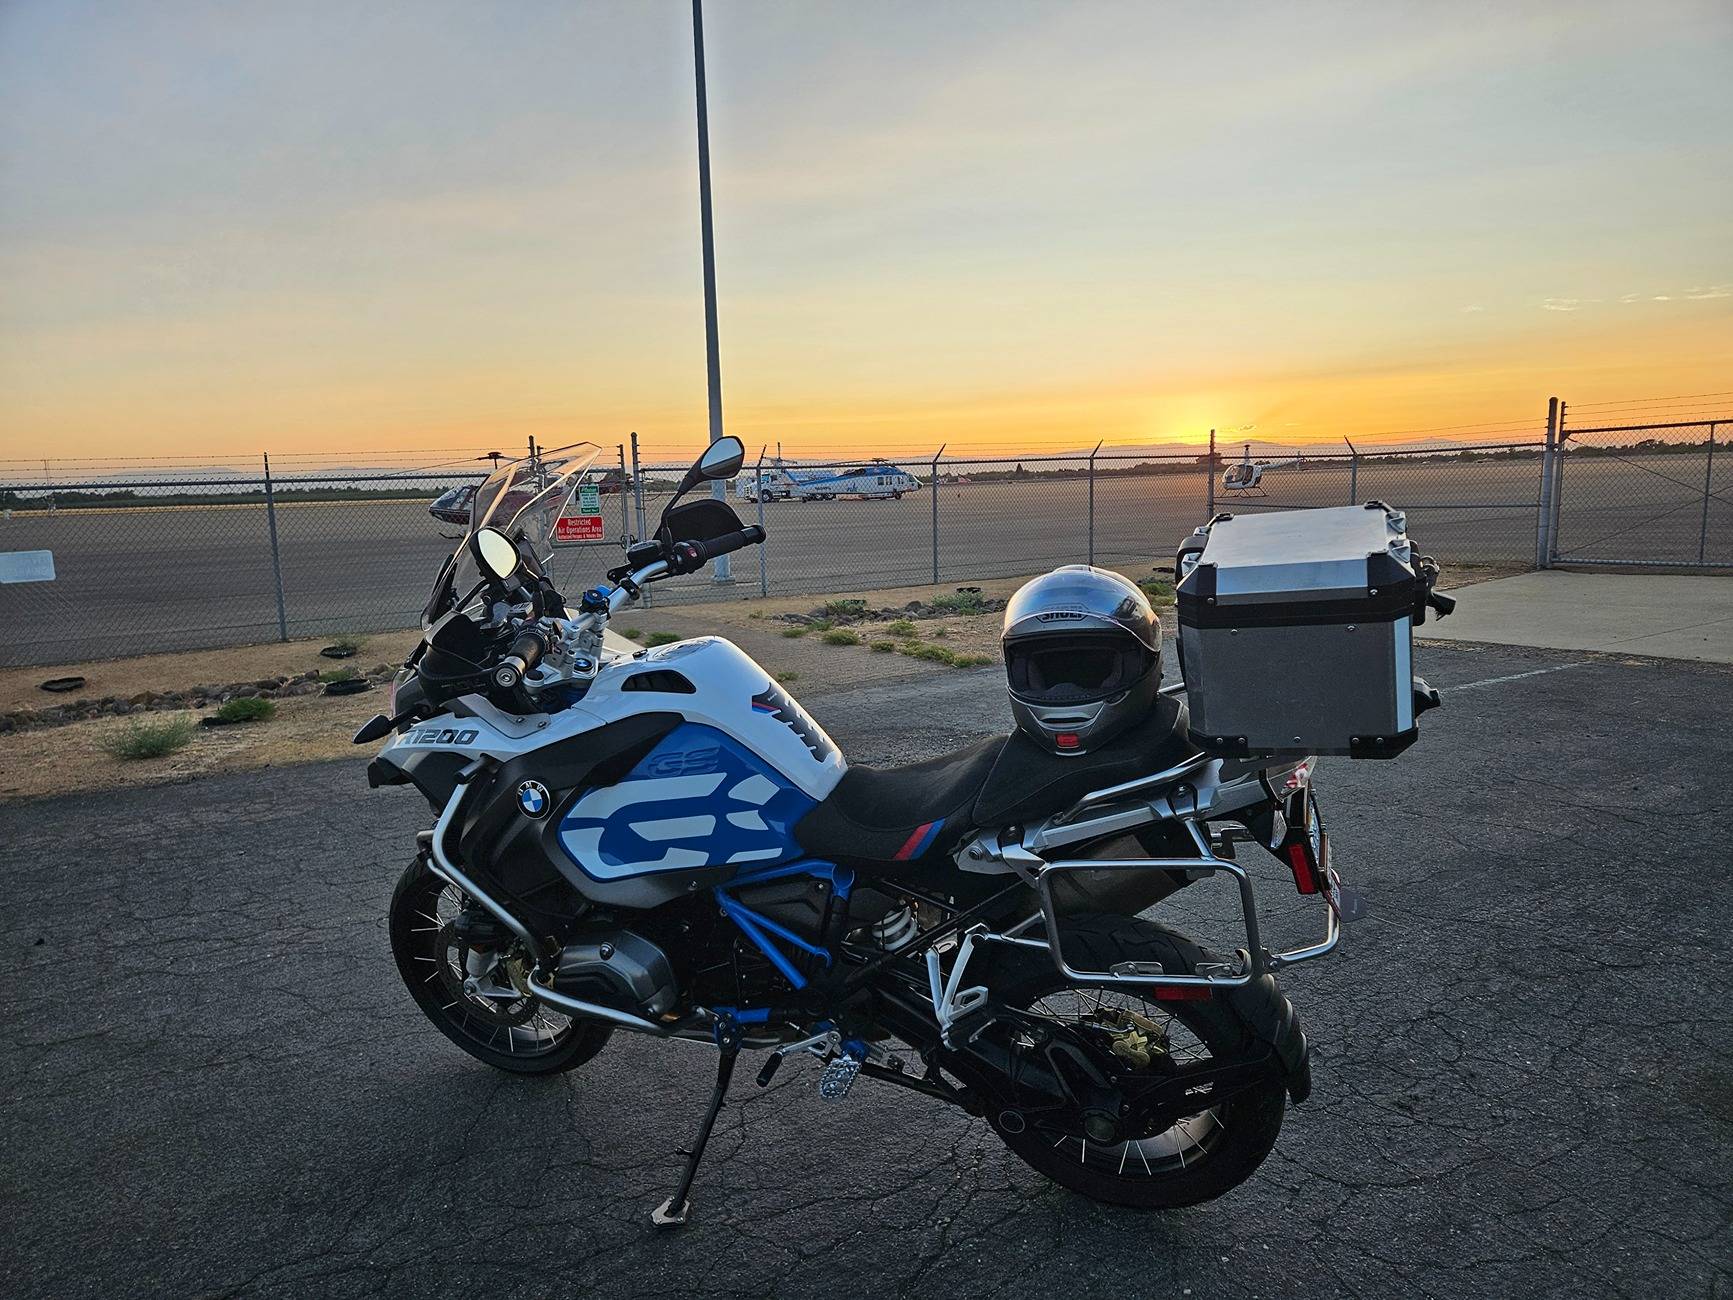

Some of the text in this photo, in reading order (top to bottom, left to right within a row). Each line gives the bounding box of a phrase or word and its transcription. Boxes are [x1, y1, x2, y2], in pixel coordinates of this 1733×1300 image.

[566, 526, 591, 535] Operations
[592, 525, 602, 533] Area
[647, 745, 720, 778] GS
[517, 781, 545, 796] BMW
